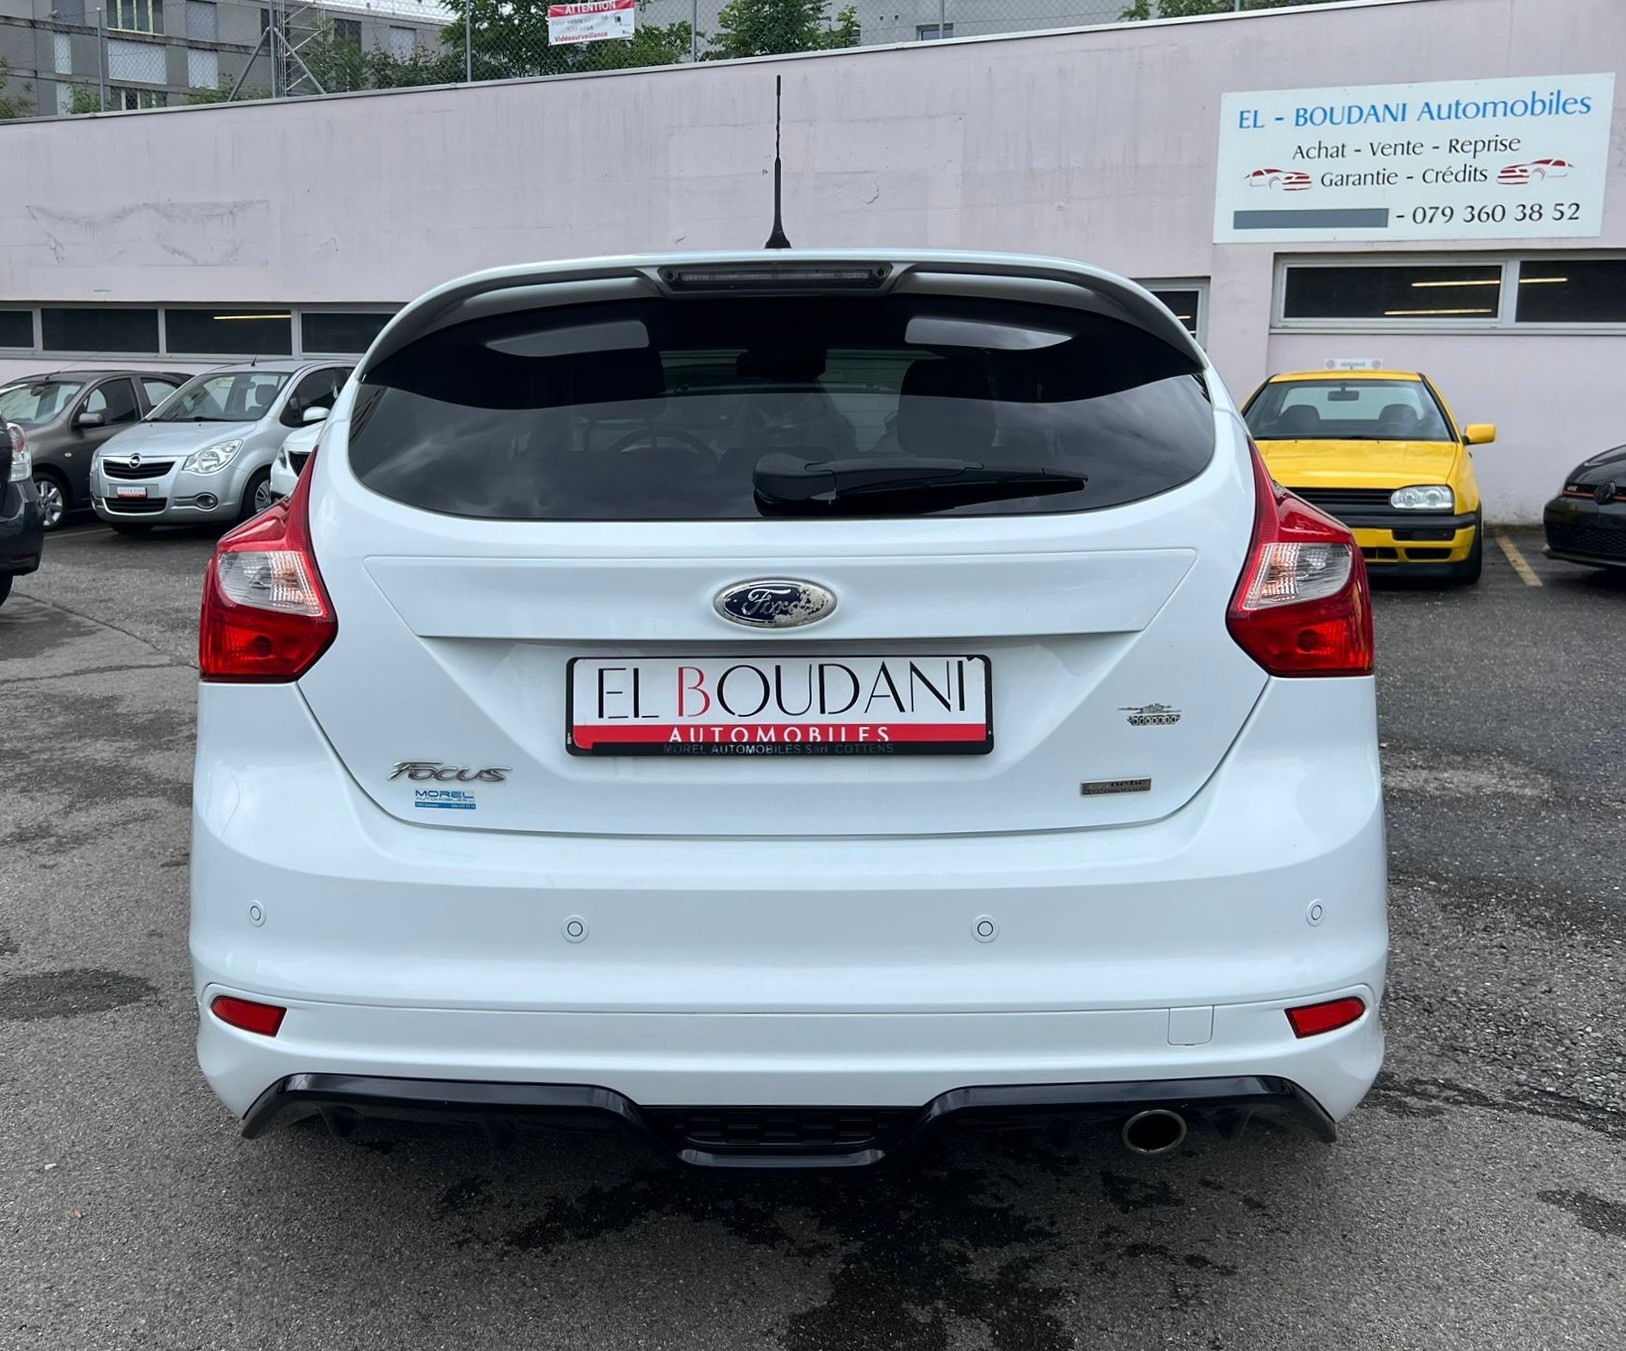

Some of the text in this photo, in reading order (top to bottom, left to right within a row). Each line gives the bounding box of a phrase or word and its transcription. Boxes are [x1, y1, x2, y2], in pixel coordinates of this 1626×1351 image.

[565, 1, 617, 15] ATTENTION
[555, 31, 608, 42] Vidéosurveillance
[1238, 109, 1265, 129] EL
[1294, 103, 1408, 127] BOUDANI
[1416, 89, 1592, 122] Automobiles
[1292, 140, 1347, 160] Achat
[1369, 139, 1424, 157] Vente
[1448, 134, 1522, 159] Reprise
[1320, 168, 1398, 188] Garantie
[1422, 164, 1489, 184] Crédits
[1412, 205, 1454, 225] 079
[1463, 204, 1506, 223] 360
[1514, 203, 1543, 222] 38
[1552, 202, 1581, 221] 52
[598, 660, 967, 720] EL BOUDANI
[668, 726, 889, 743] AUTOMOBILES
[663, 743, 705, 755] MOREL
[711, 743, 801, 755] AUTOMOBILES
[834, 743, 895, 755] COTTENS
[415, 789, 474, 799] MOREL
